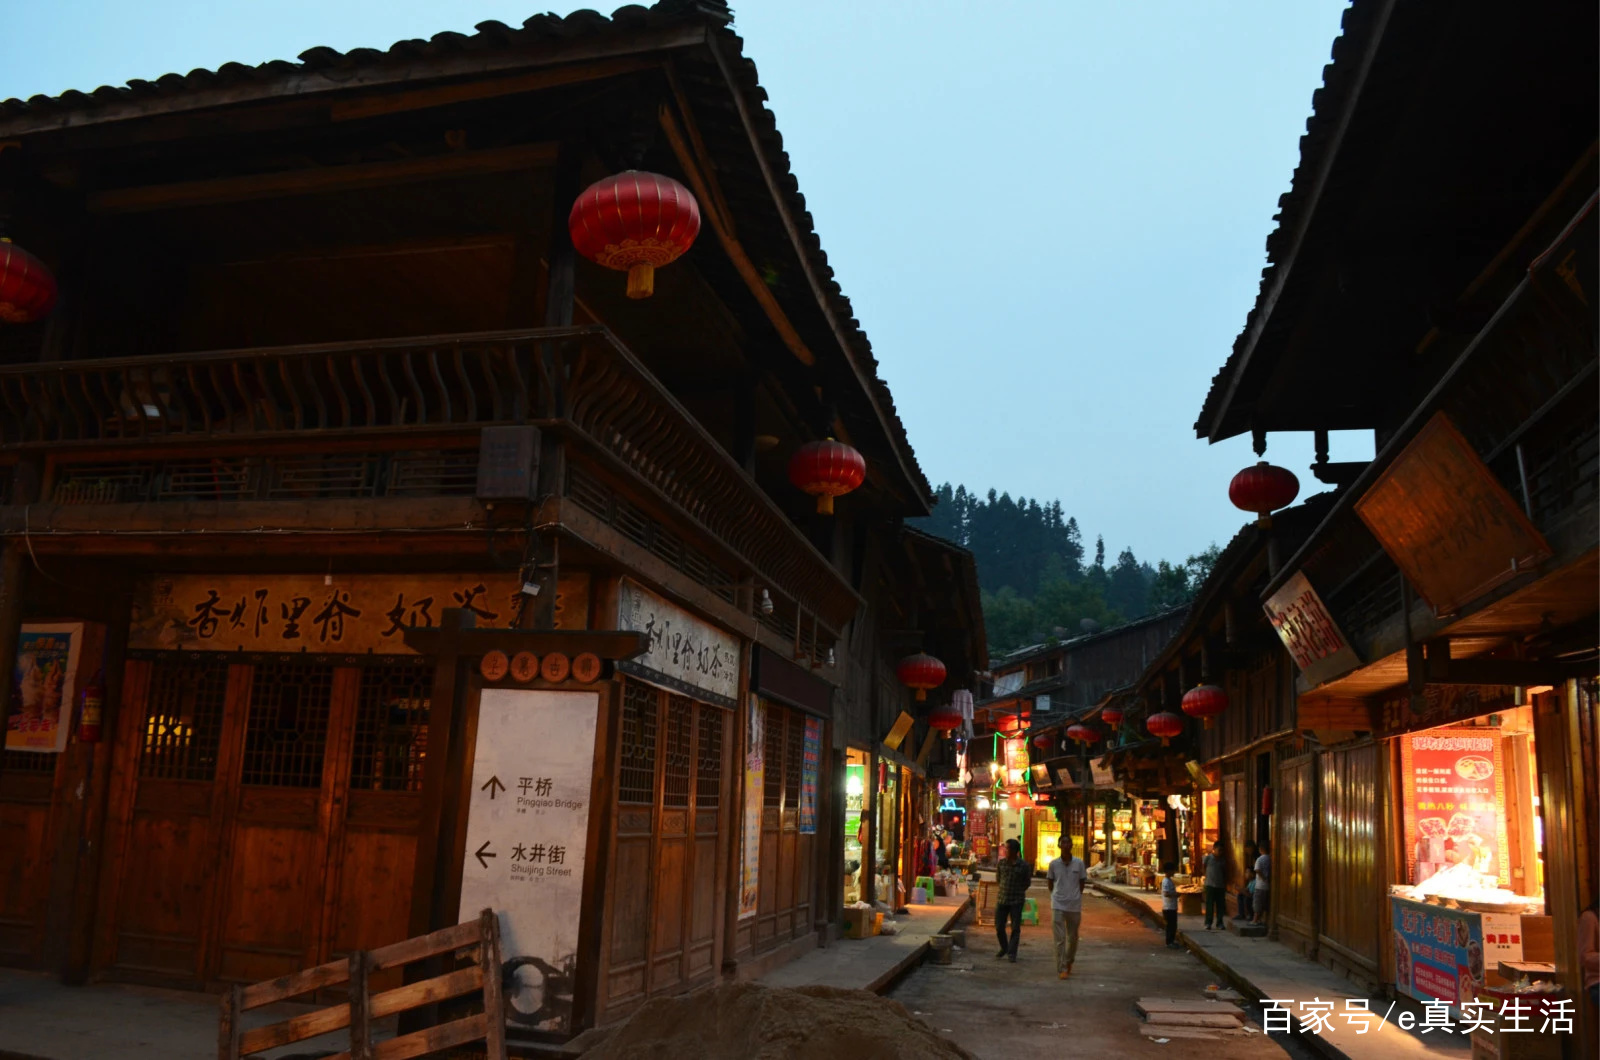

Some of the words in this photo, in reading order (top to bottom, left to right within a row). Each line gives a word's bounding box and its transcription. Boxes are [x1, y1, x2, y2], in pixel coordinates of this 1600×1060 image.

[517, 777, 553, 798] 平桥
[517, 797, 554, 809] Pingqiao
[554, 799, 583, 811] Bridge
[510, 843, 567, 865] 水井街
[511, 864, 545, 877] Shuijing
[546, 866, 572, 877] Street
